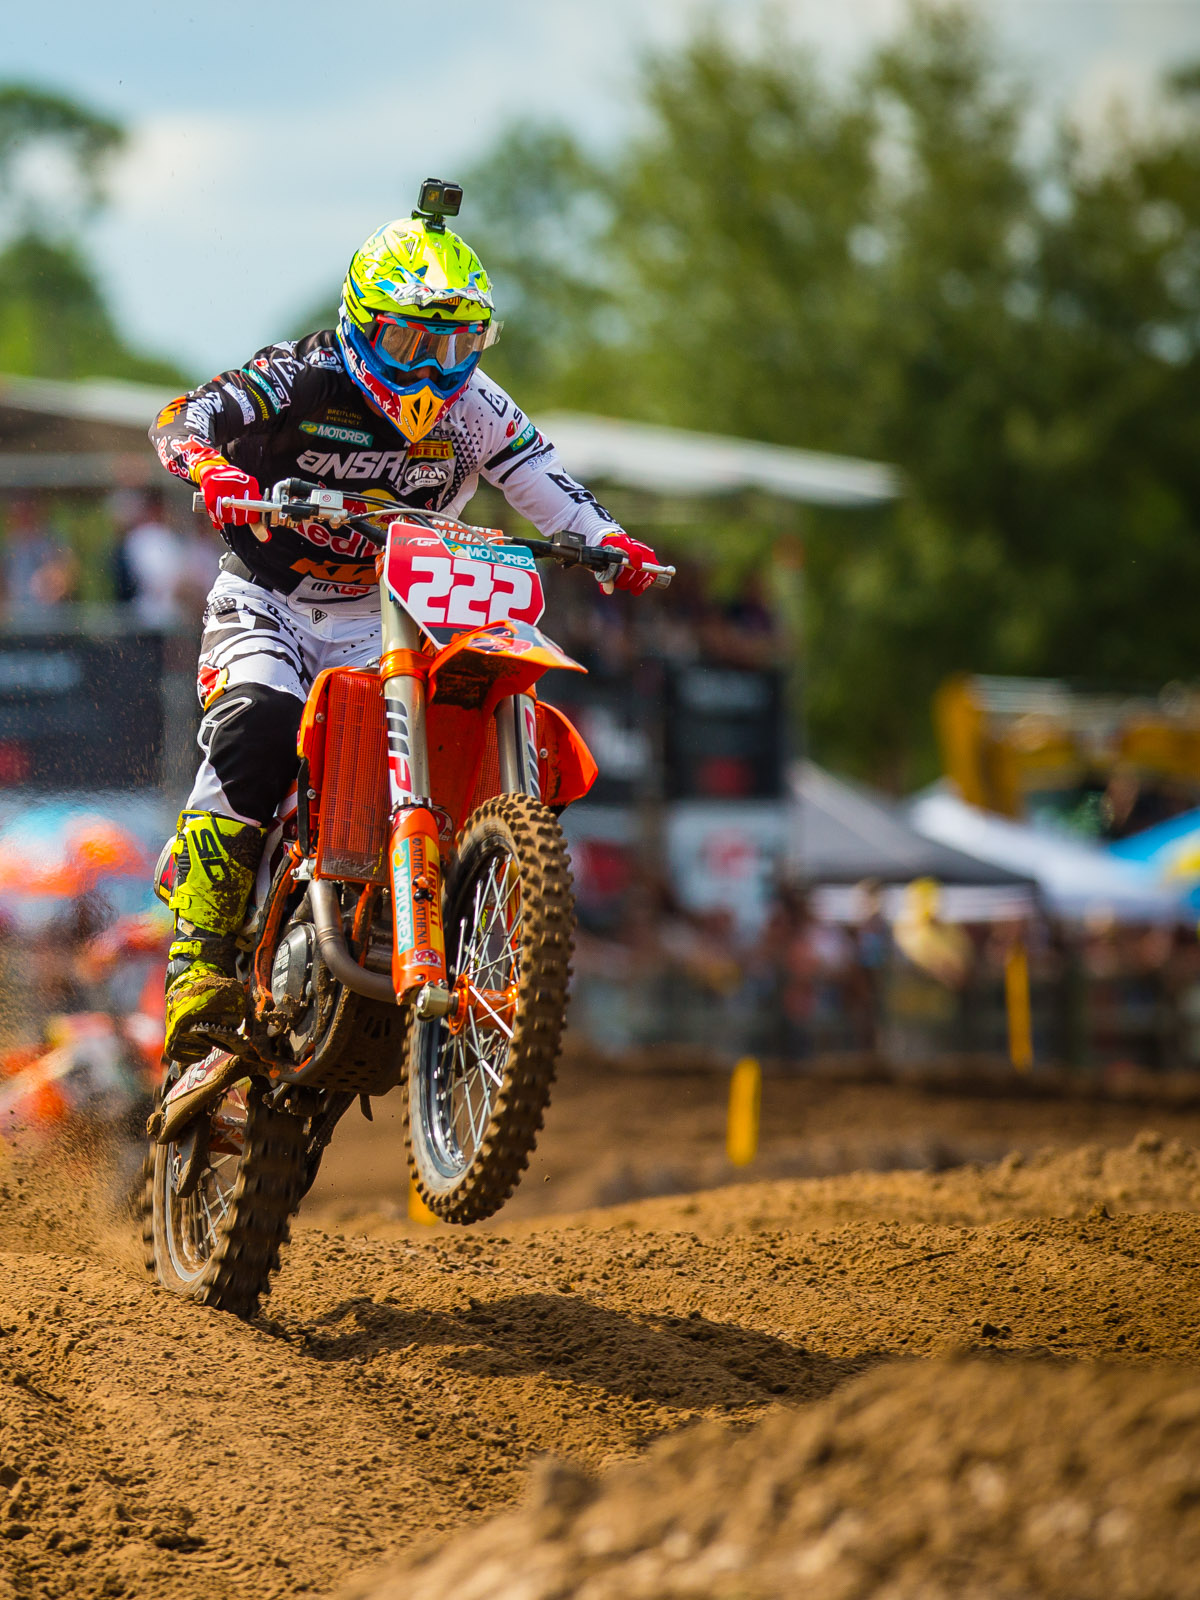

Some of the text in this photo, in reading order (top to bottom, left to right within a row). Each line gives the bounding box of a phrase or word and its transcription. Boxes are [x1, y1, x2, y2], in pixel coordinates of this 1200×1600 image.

[317, 424, 370, 446] MOTOREX
[392, 535, 442, 548] MXGP
[465, 545, 535, 568] MOTOREX
[311, 582, 371, 597] MXGP
[407, 555, 533, 627] 222
[393, 865, 414, 948] MOTOREX
[414, 901, 428, 946] ATHENA
